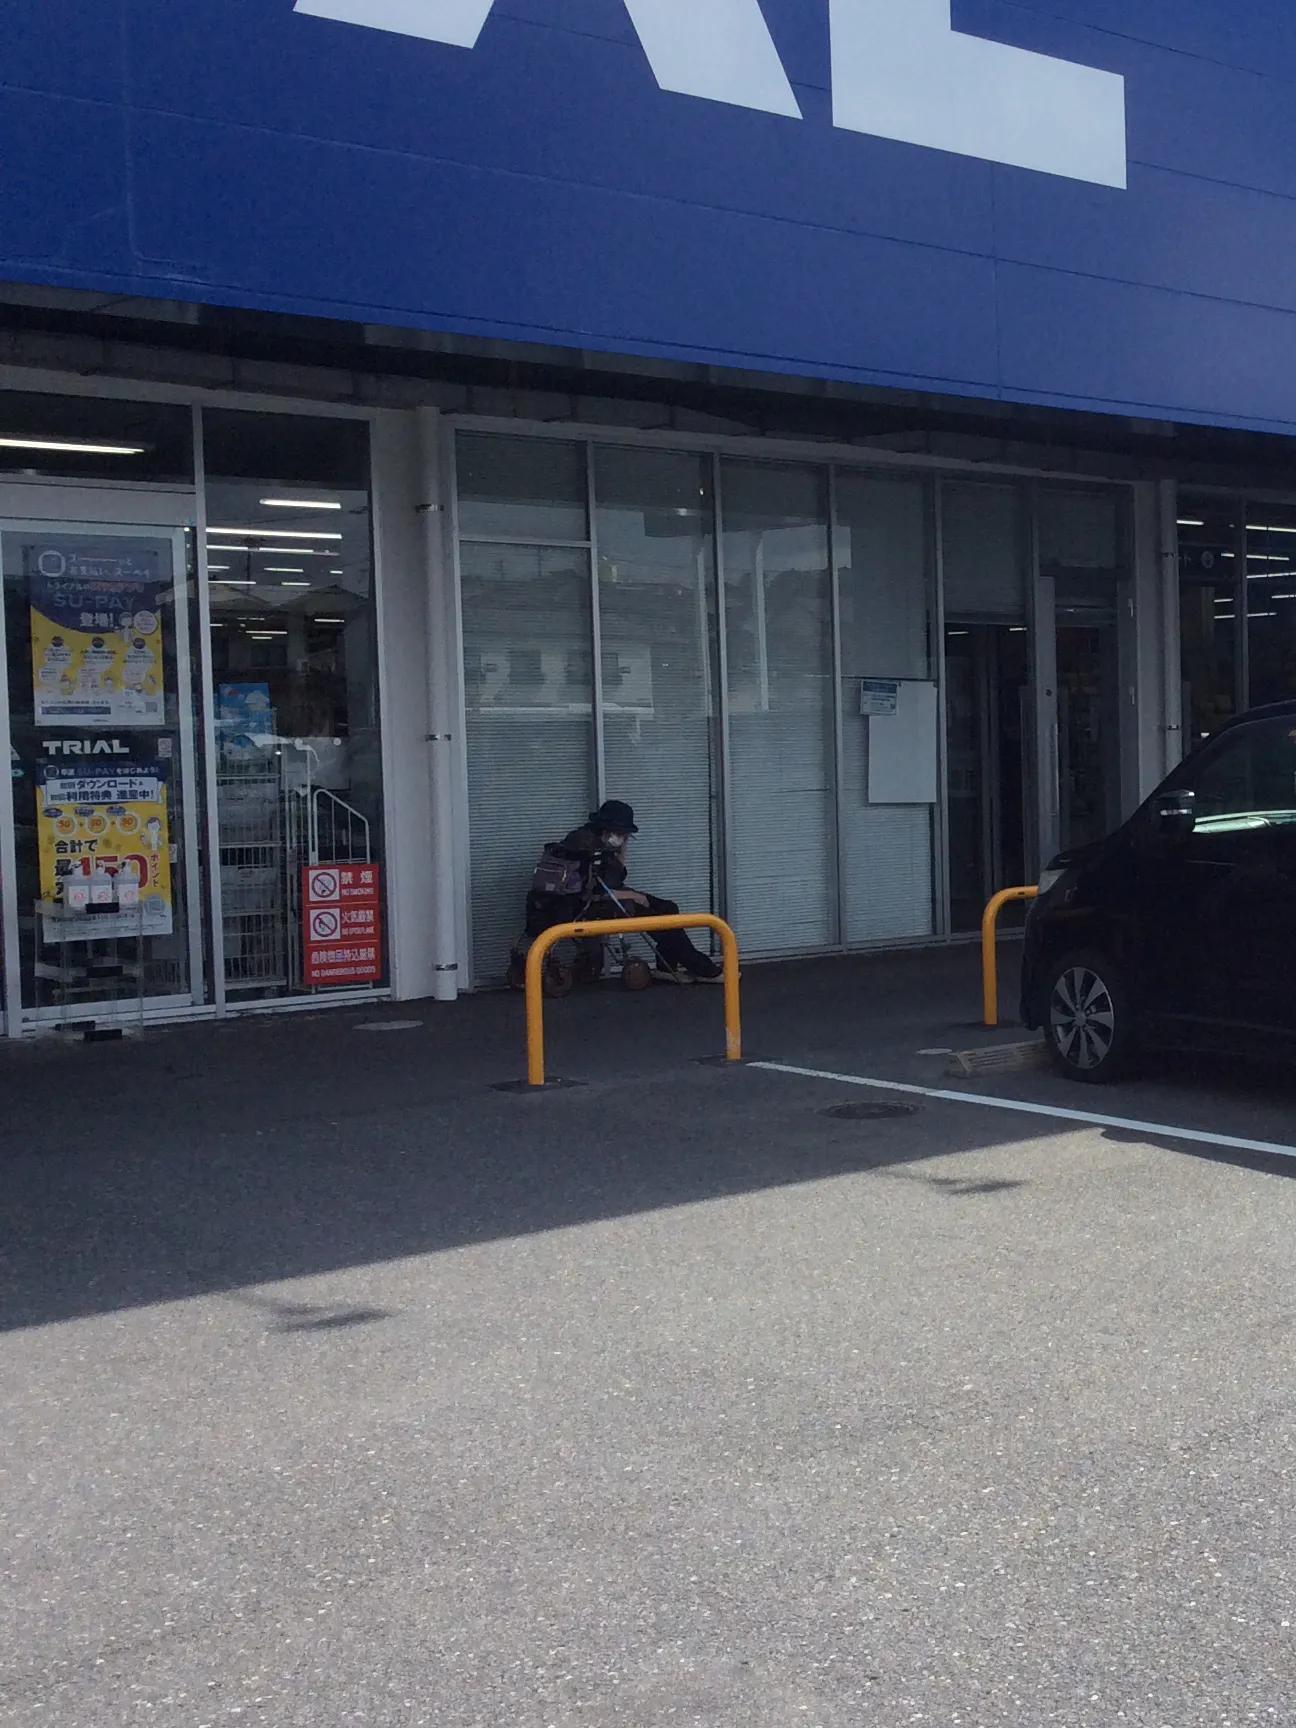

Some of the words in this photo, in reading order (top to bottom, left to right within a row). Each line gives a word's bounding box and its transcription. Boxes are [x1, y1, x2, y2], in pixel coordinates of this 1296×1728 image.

[53, 592, 135, 609] SU-PAY
[42, 739, 130, 755] TRIAL
[55, 839, 98, 854] 合計で
[151, 853, 160, 887] ポイント
